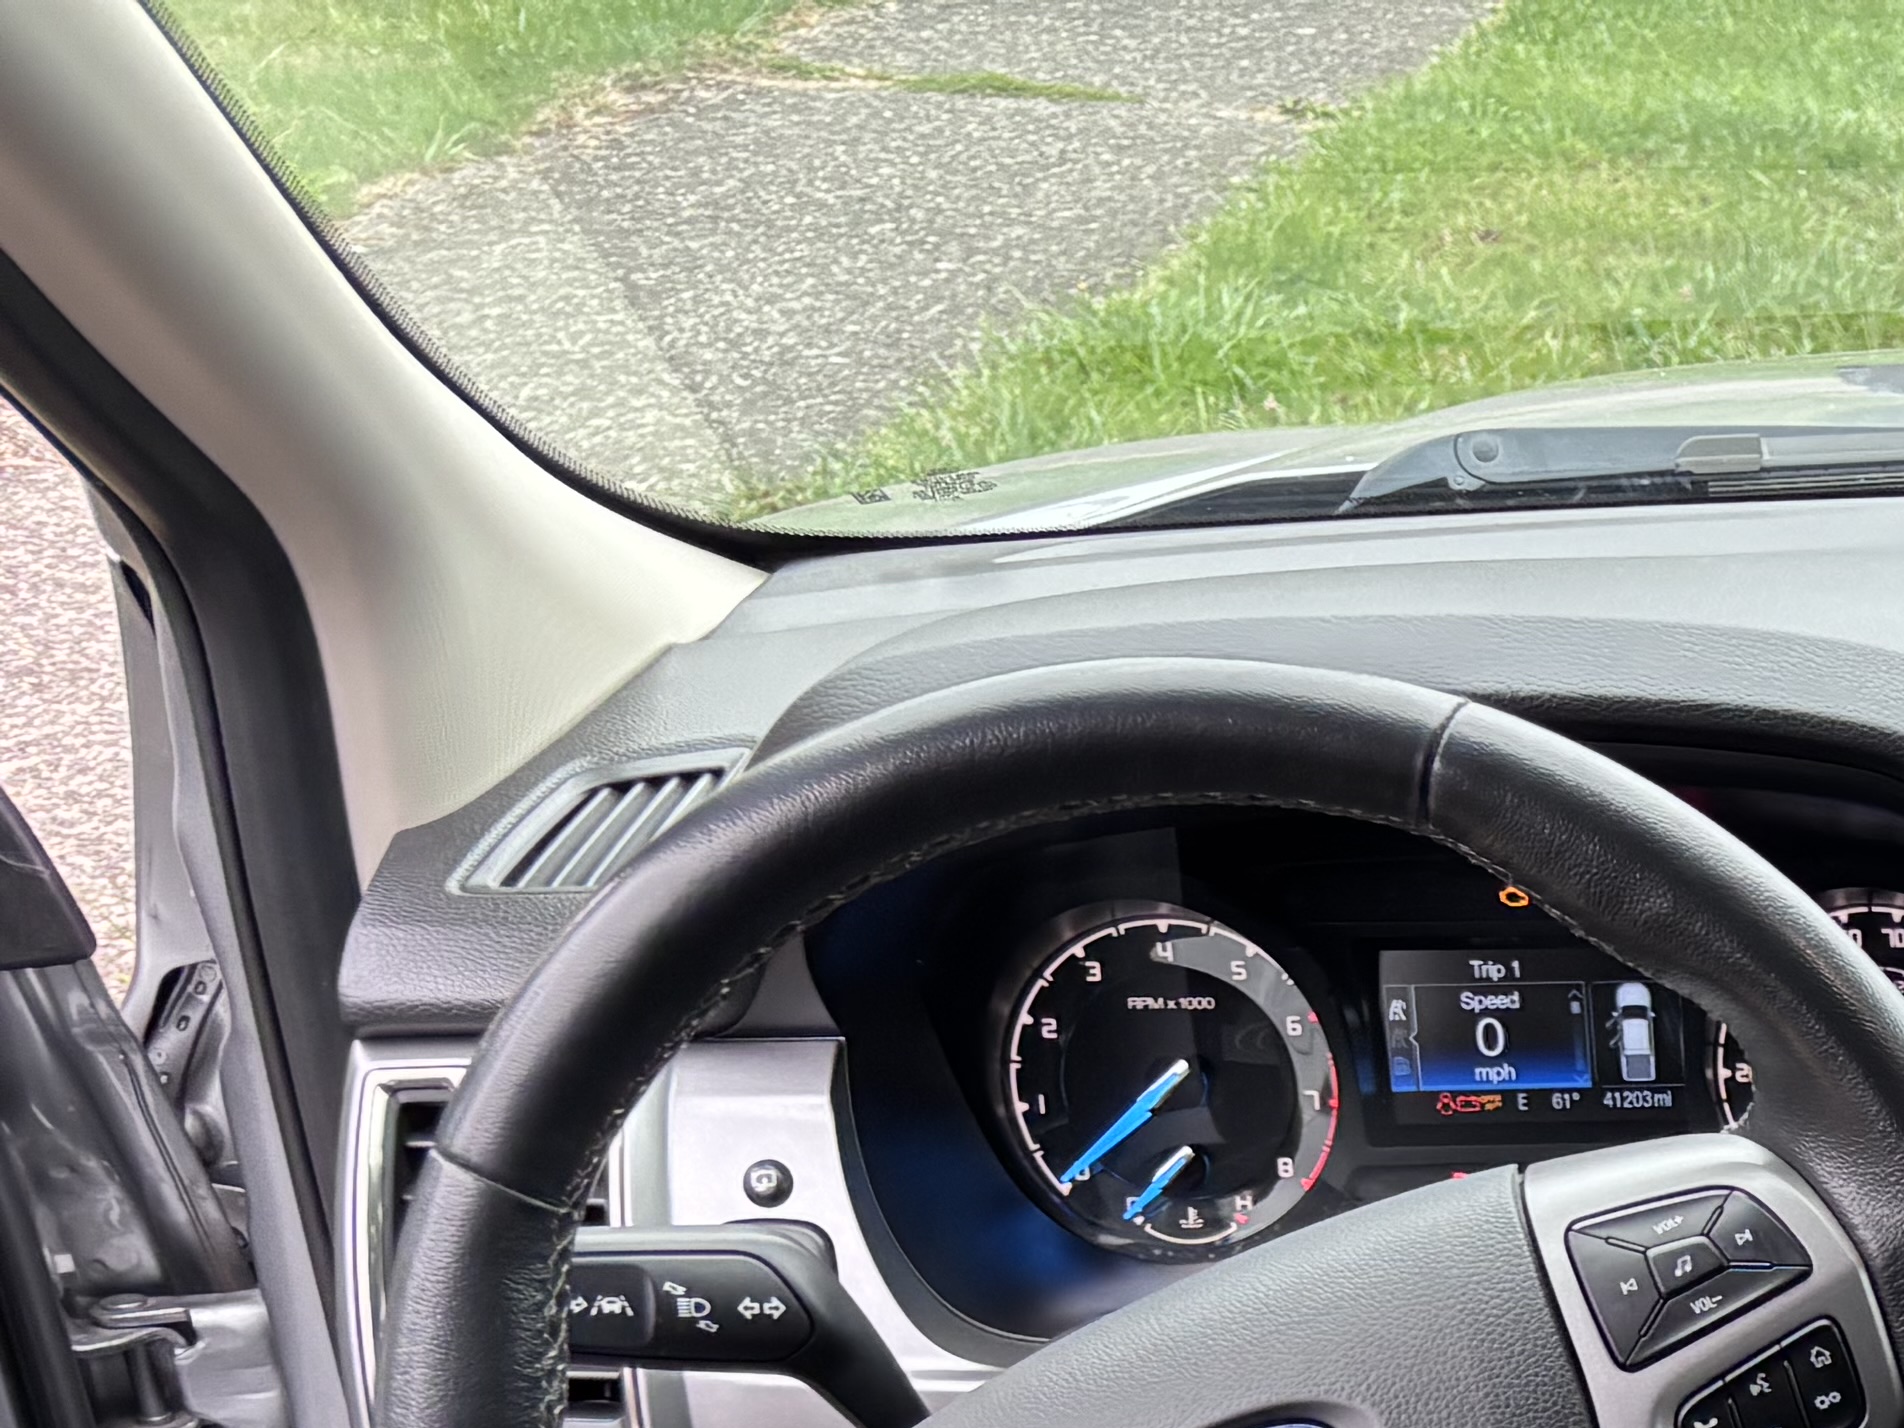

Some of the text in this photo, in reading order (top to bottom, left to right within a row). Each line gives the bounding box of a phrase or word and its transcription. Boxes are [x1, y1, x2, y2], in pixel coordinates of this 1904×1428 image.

[1156, 942, 1174, 961] 4
[1086, 961, 1102, 982] 3
[1231, 962, 1247, 981] 5
[1469, 960, 1520, 981] Trip 1
[1127, 997, 1216, 1010] RPM x 1000
[1460, 992, 1520, 1014] Speed
[1041, 1018, 1058, 1039] 2
[1286, 1016, 1303, 1036] 6
[1475, 1017, 1506, 1057] 0
[1474, 1065, 1517, 1085] mph
[1039, 1094, 1046, 1114] 1
[1303, 1090, 1321, 1110] 7
[1517, 1092, 1580, 1111] E 61°
[1277, 1157, 1294, 1178] 8
[1235, 1194, 1253, 1211] H
